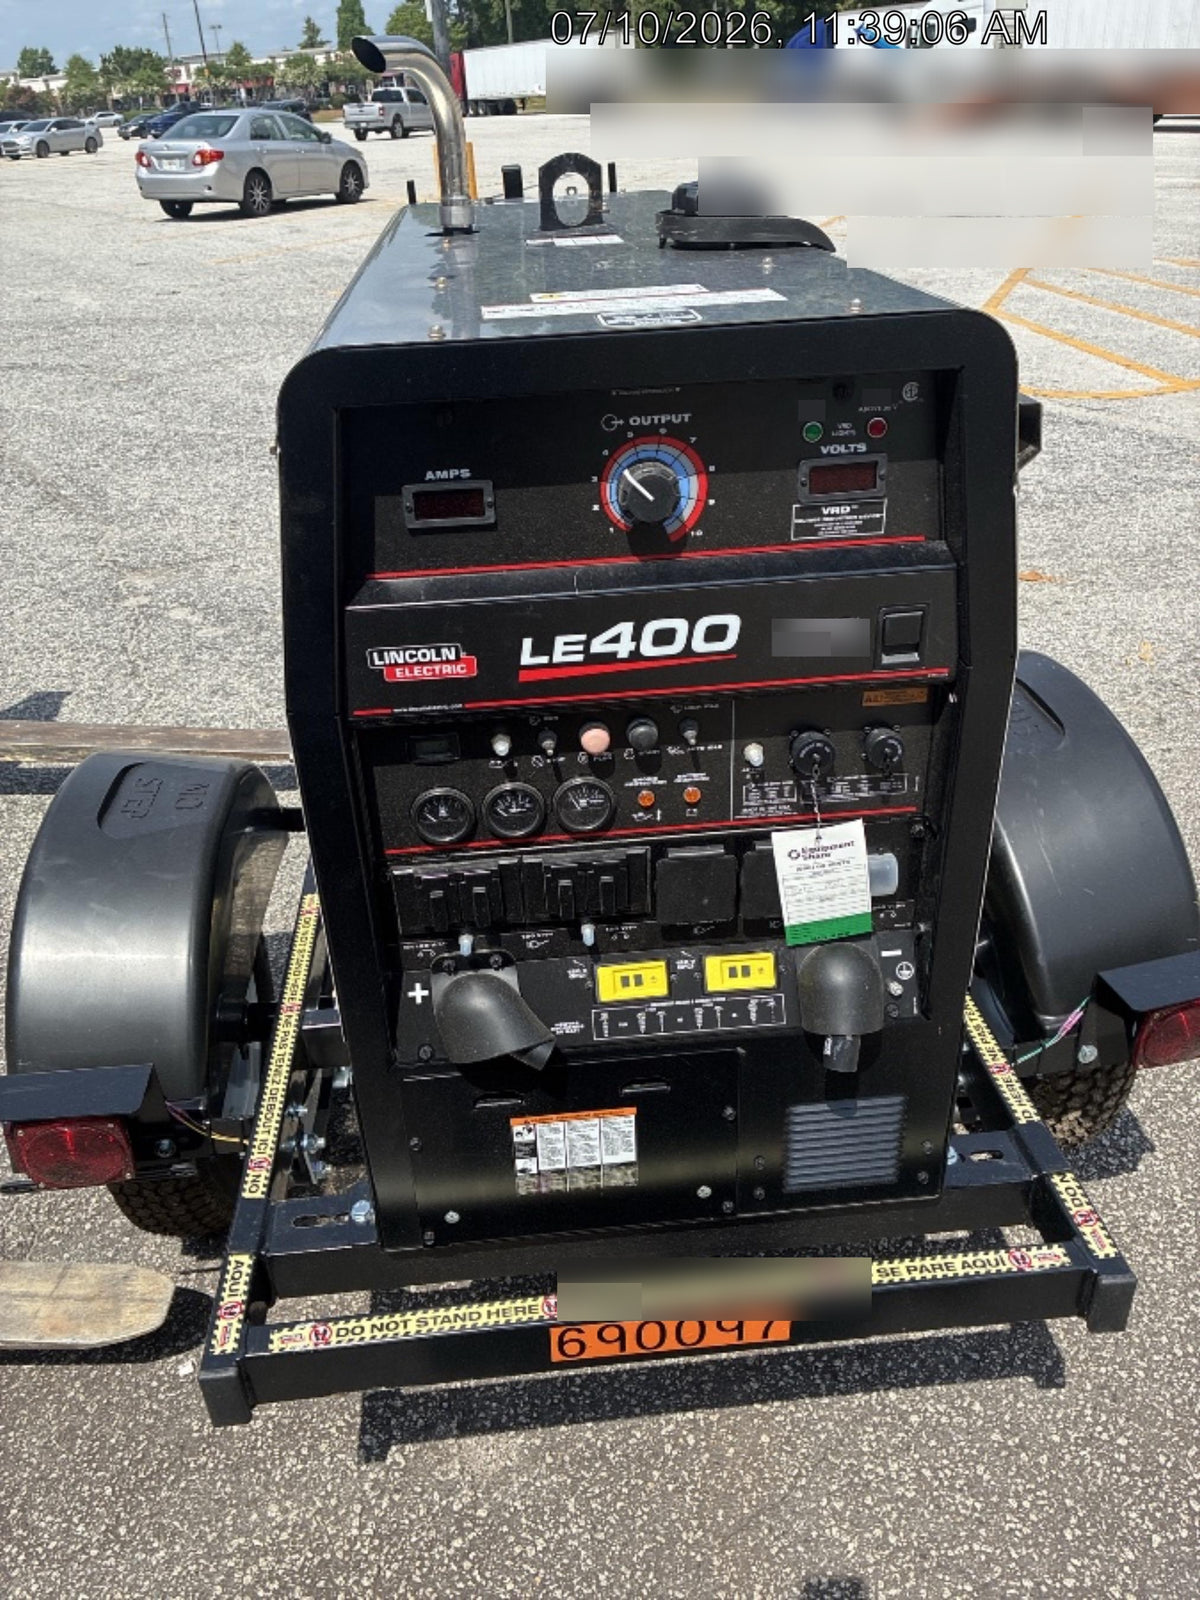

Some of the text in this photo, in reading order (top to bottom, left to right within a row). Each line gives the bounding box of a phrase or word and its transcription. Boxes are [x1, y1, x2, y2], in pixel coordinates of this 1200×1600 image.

[629, 413, 692, 426] OUTPUT
[820, 442, 867, 454] VOLTS
[424, 468, 472, 481] AMPS
[520, 614, 741, 666] LE400
[373, 646, 456, 666] LINCOLN
[395, 664, 467, 678] ELECTRIC
[249, 1174, 260, 1194] NO
[876, 1267, 900, 1279] SE
[906, 1261, 956, 1277] PARE
[336, 1302, 540, 1339] DO NOT STAND HERE
